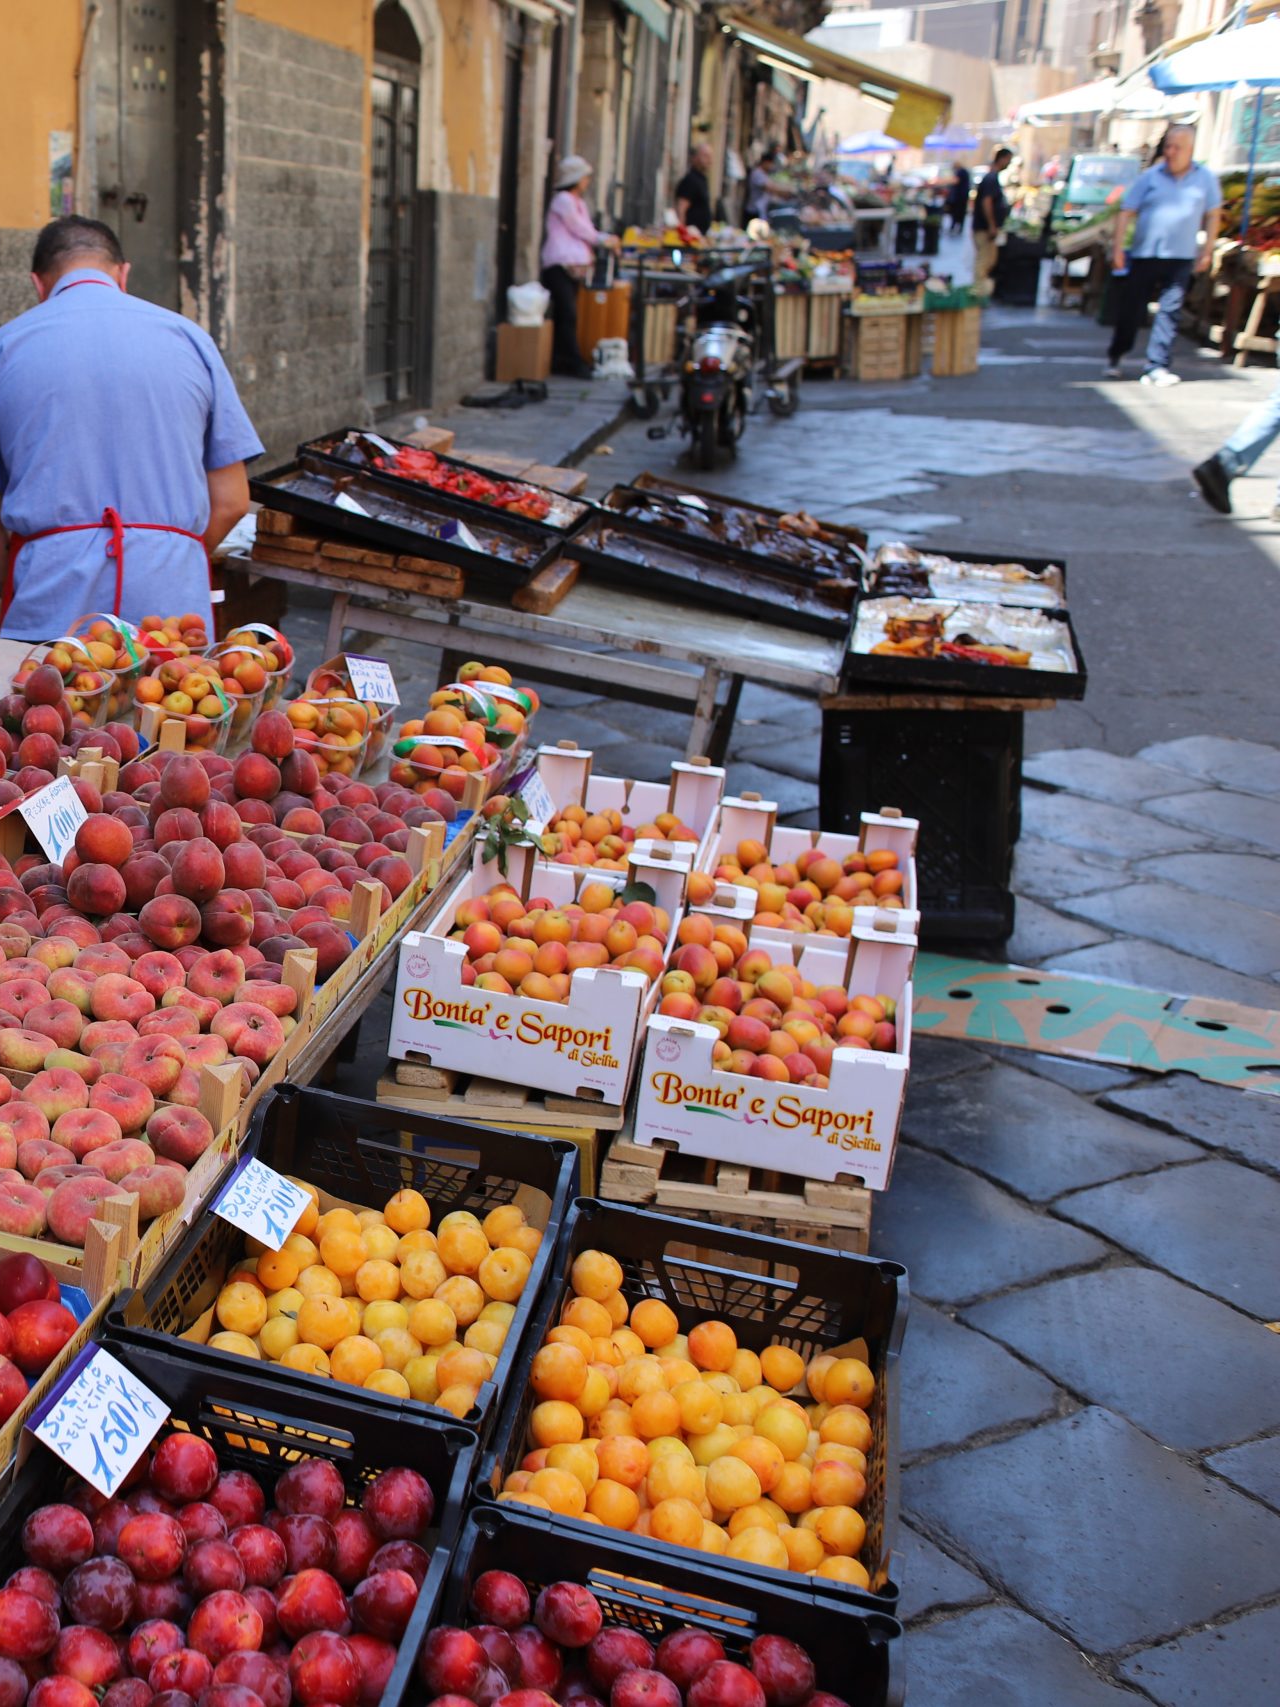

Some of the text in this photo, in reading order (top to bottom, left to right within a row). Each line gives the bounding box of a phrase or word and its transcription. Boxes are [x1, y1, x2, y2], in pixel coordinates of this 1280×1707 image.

[403, 988, 491, 1027] Bonta'
[495, 1012, 512, 1031] e
[516, 1011, 613, 1054] Sapori
[568, 1048, 620, 1070] di Sicilia
[651, 1071, 874, 1136] Bonta' e Sapori
[827, 1131, 881, 1152] di Sicilia
[219, 1160, 261, 1218] SUSINE
[42, 1358, 102, 1440] SUSINE
